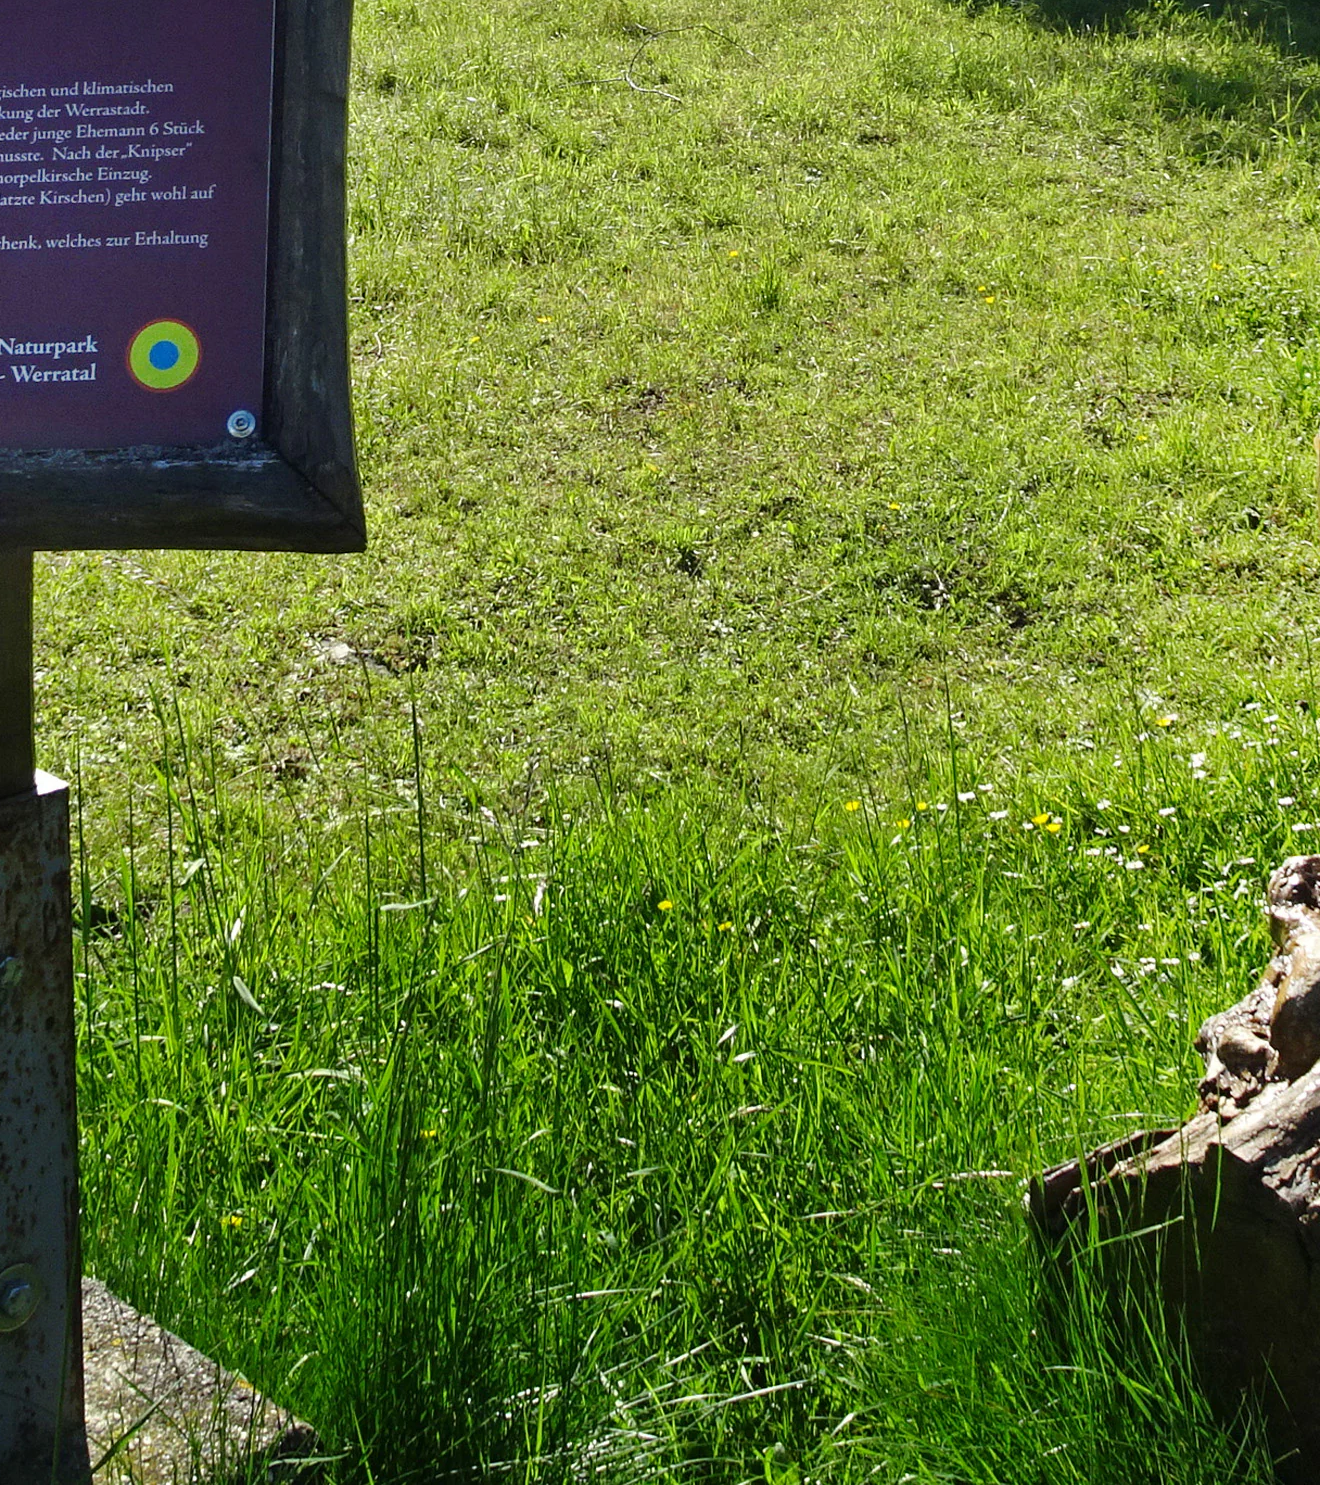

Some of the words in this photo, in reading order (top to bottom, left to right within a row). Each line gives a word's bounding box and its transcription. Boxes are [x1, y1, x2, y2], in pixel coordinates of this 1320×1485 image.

[50, 82, 79, 96] und
[83, 79, 173, 95] klimatischen
[37, 104, 61, 118] der
[64, 101, 150, 116] Werrastadt.
[30, 127, 72, 144] junge
[76, 124, 145, 138] Ehemann
[149, 122, 159, 135] 6
[163, 120, 205, 135] Stück
[52, 146, 91, 161] Nach
[95, 145, 122, 159] der
[98, 167, 152, 184] Einzug.
[40, 188, 111, 205] Kirschen)
[114, 187, 147, 207] geht
[151, 186, 186, 200] wohl
[190, 184, 216, 199] auf
[46, 233, 101, 248] welches
[106, 237, 131, 246] zur
[135, 230, 208, 248] Erhaltung
[10, 363, 96, 382] Werratal
